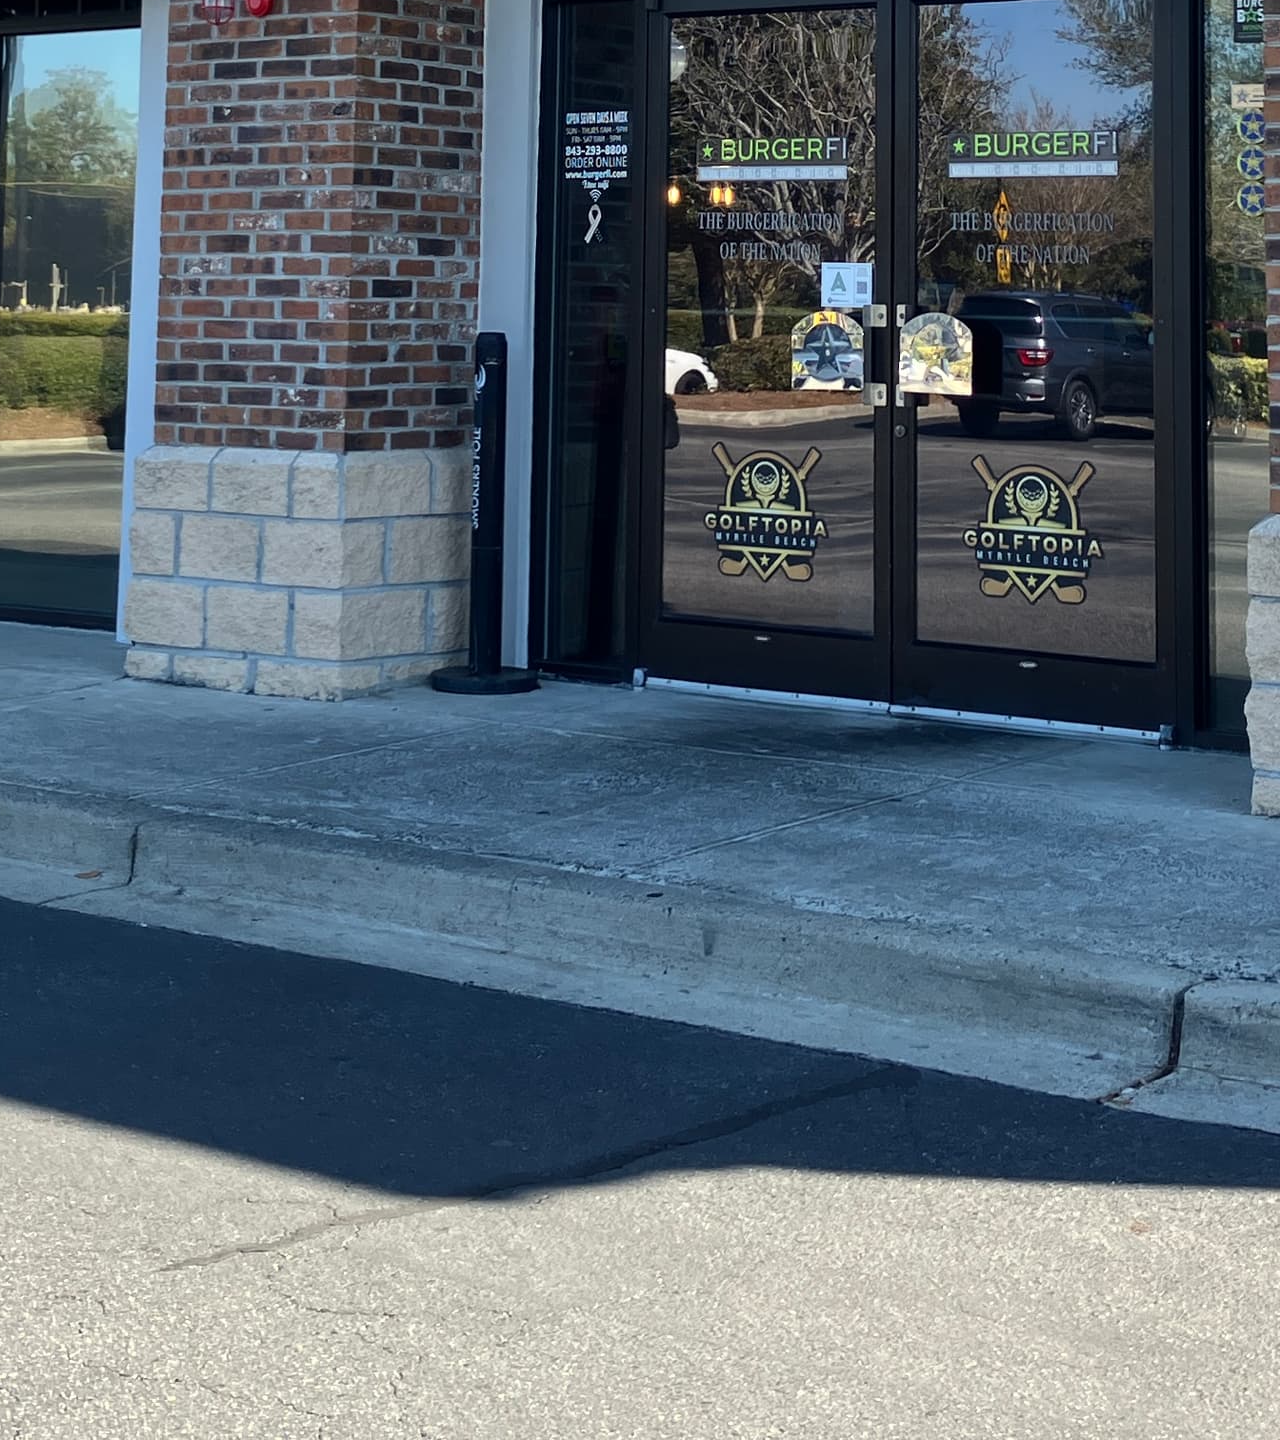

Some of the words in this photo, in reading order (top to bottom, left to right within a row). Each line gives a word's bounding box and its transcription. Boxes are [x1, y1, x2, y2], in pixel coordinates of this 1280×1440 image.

[721, 137, 847, 160] BURGERFI
[974, 130, 1117, 157] BURGERFI
[565, 156, 594, 169] ORDER
[595, 155, 628, 168] ONLINE
[699, 211, 726, 230] THE
[728, 211, 844, 231] BURGERFICATION
[950, 211, 980, 231] THE
[984, 211, 1114, 233] BURGERFICATION
[720, 241, 738, 260] OF
[739, 242, 768, 261] THE
[769, 241, 821, 262] NATION
[976, 244, 995, 263] OF
[998, 244, 1030, 264] THE
[1032, 245, 1090, 265] NATION
[830, 271, 847, 292] A
[705, 513, 828, 538] GOLFTOPIA
[715, 532, 764, 544] MYRTLE
[774, 535, 816, 548] BEACH
[964, 530, 1103, 558] GOLFTOPIA
[976, 550, 1032, 564] MYRTLE
[1043, 555, 1090, 569] BEACH
